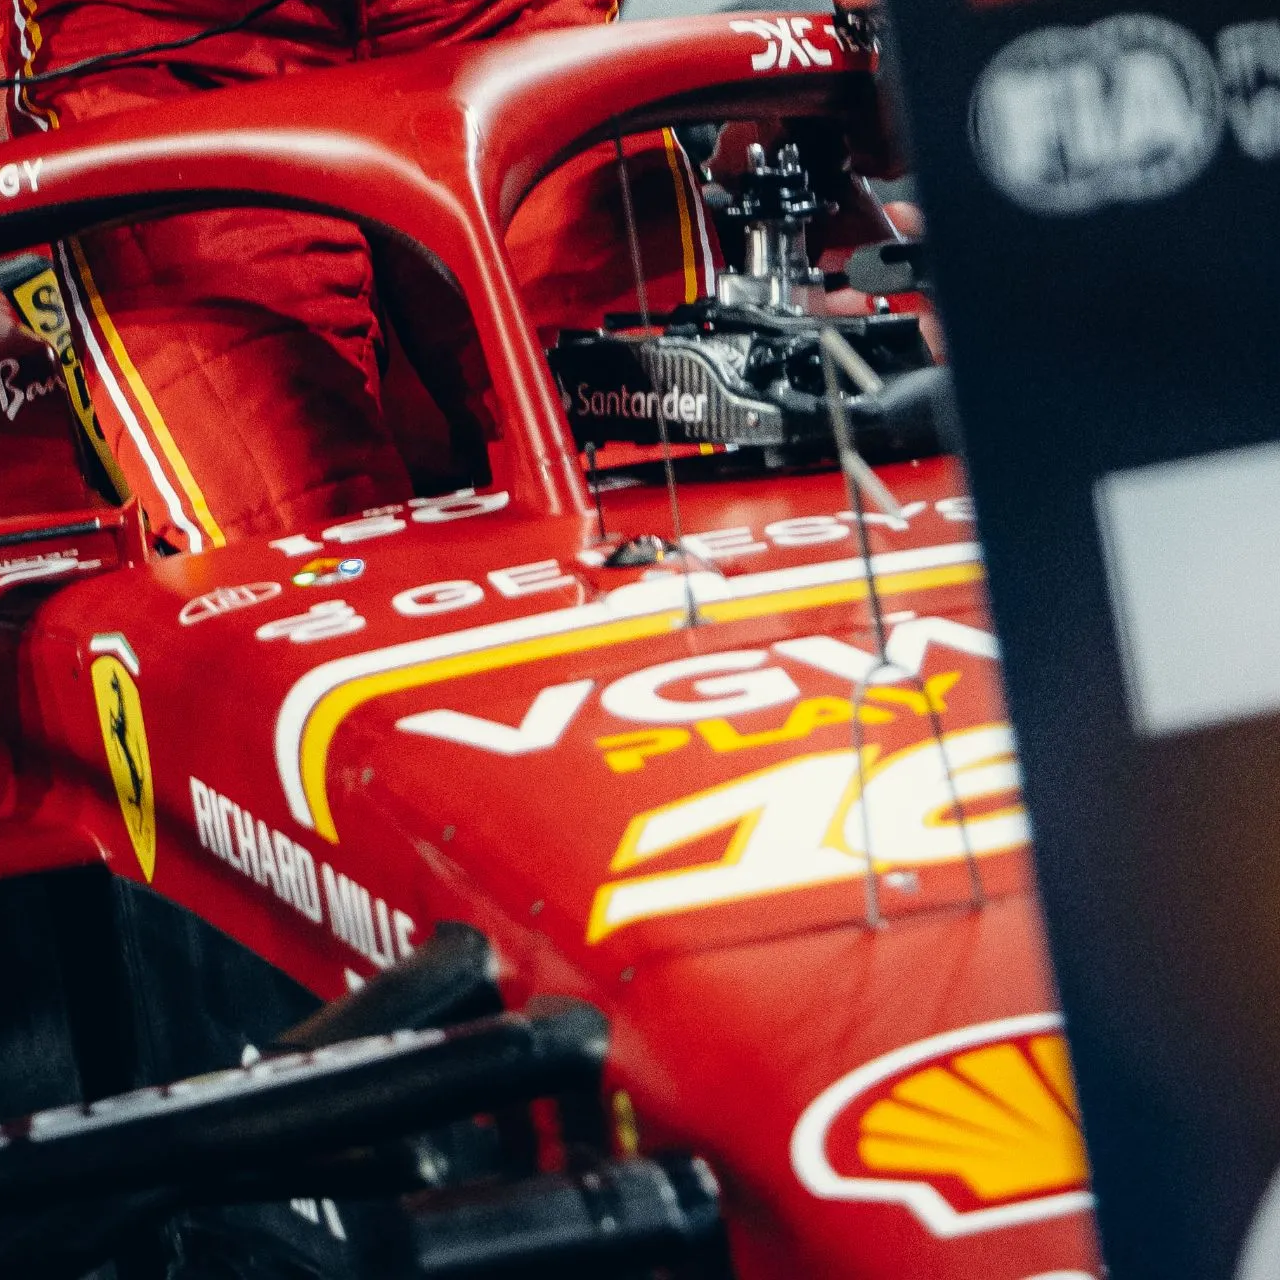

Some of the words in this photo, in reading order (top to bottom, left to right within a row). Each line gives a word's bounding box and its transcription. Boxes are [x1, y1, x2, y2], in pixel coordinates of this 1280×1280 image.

[577, 382, 708, 424] Santander
[395, 616, 1003, 756] VGW
[595, 671, 963, 774] PLAY
[189, 775, 322, 925] RICHARD
[321, 861, 416, 970] MILLE
